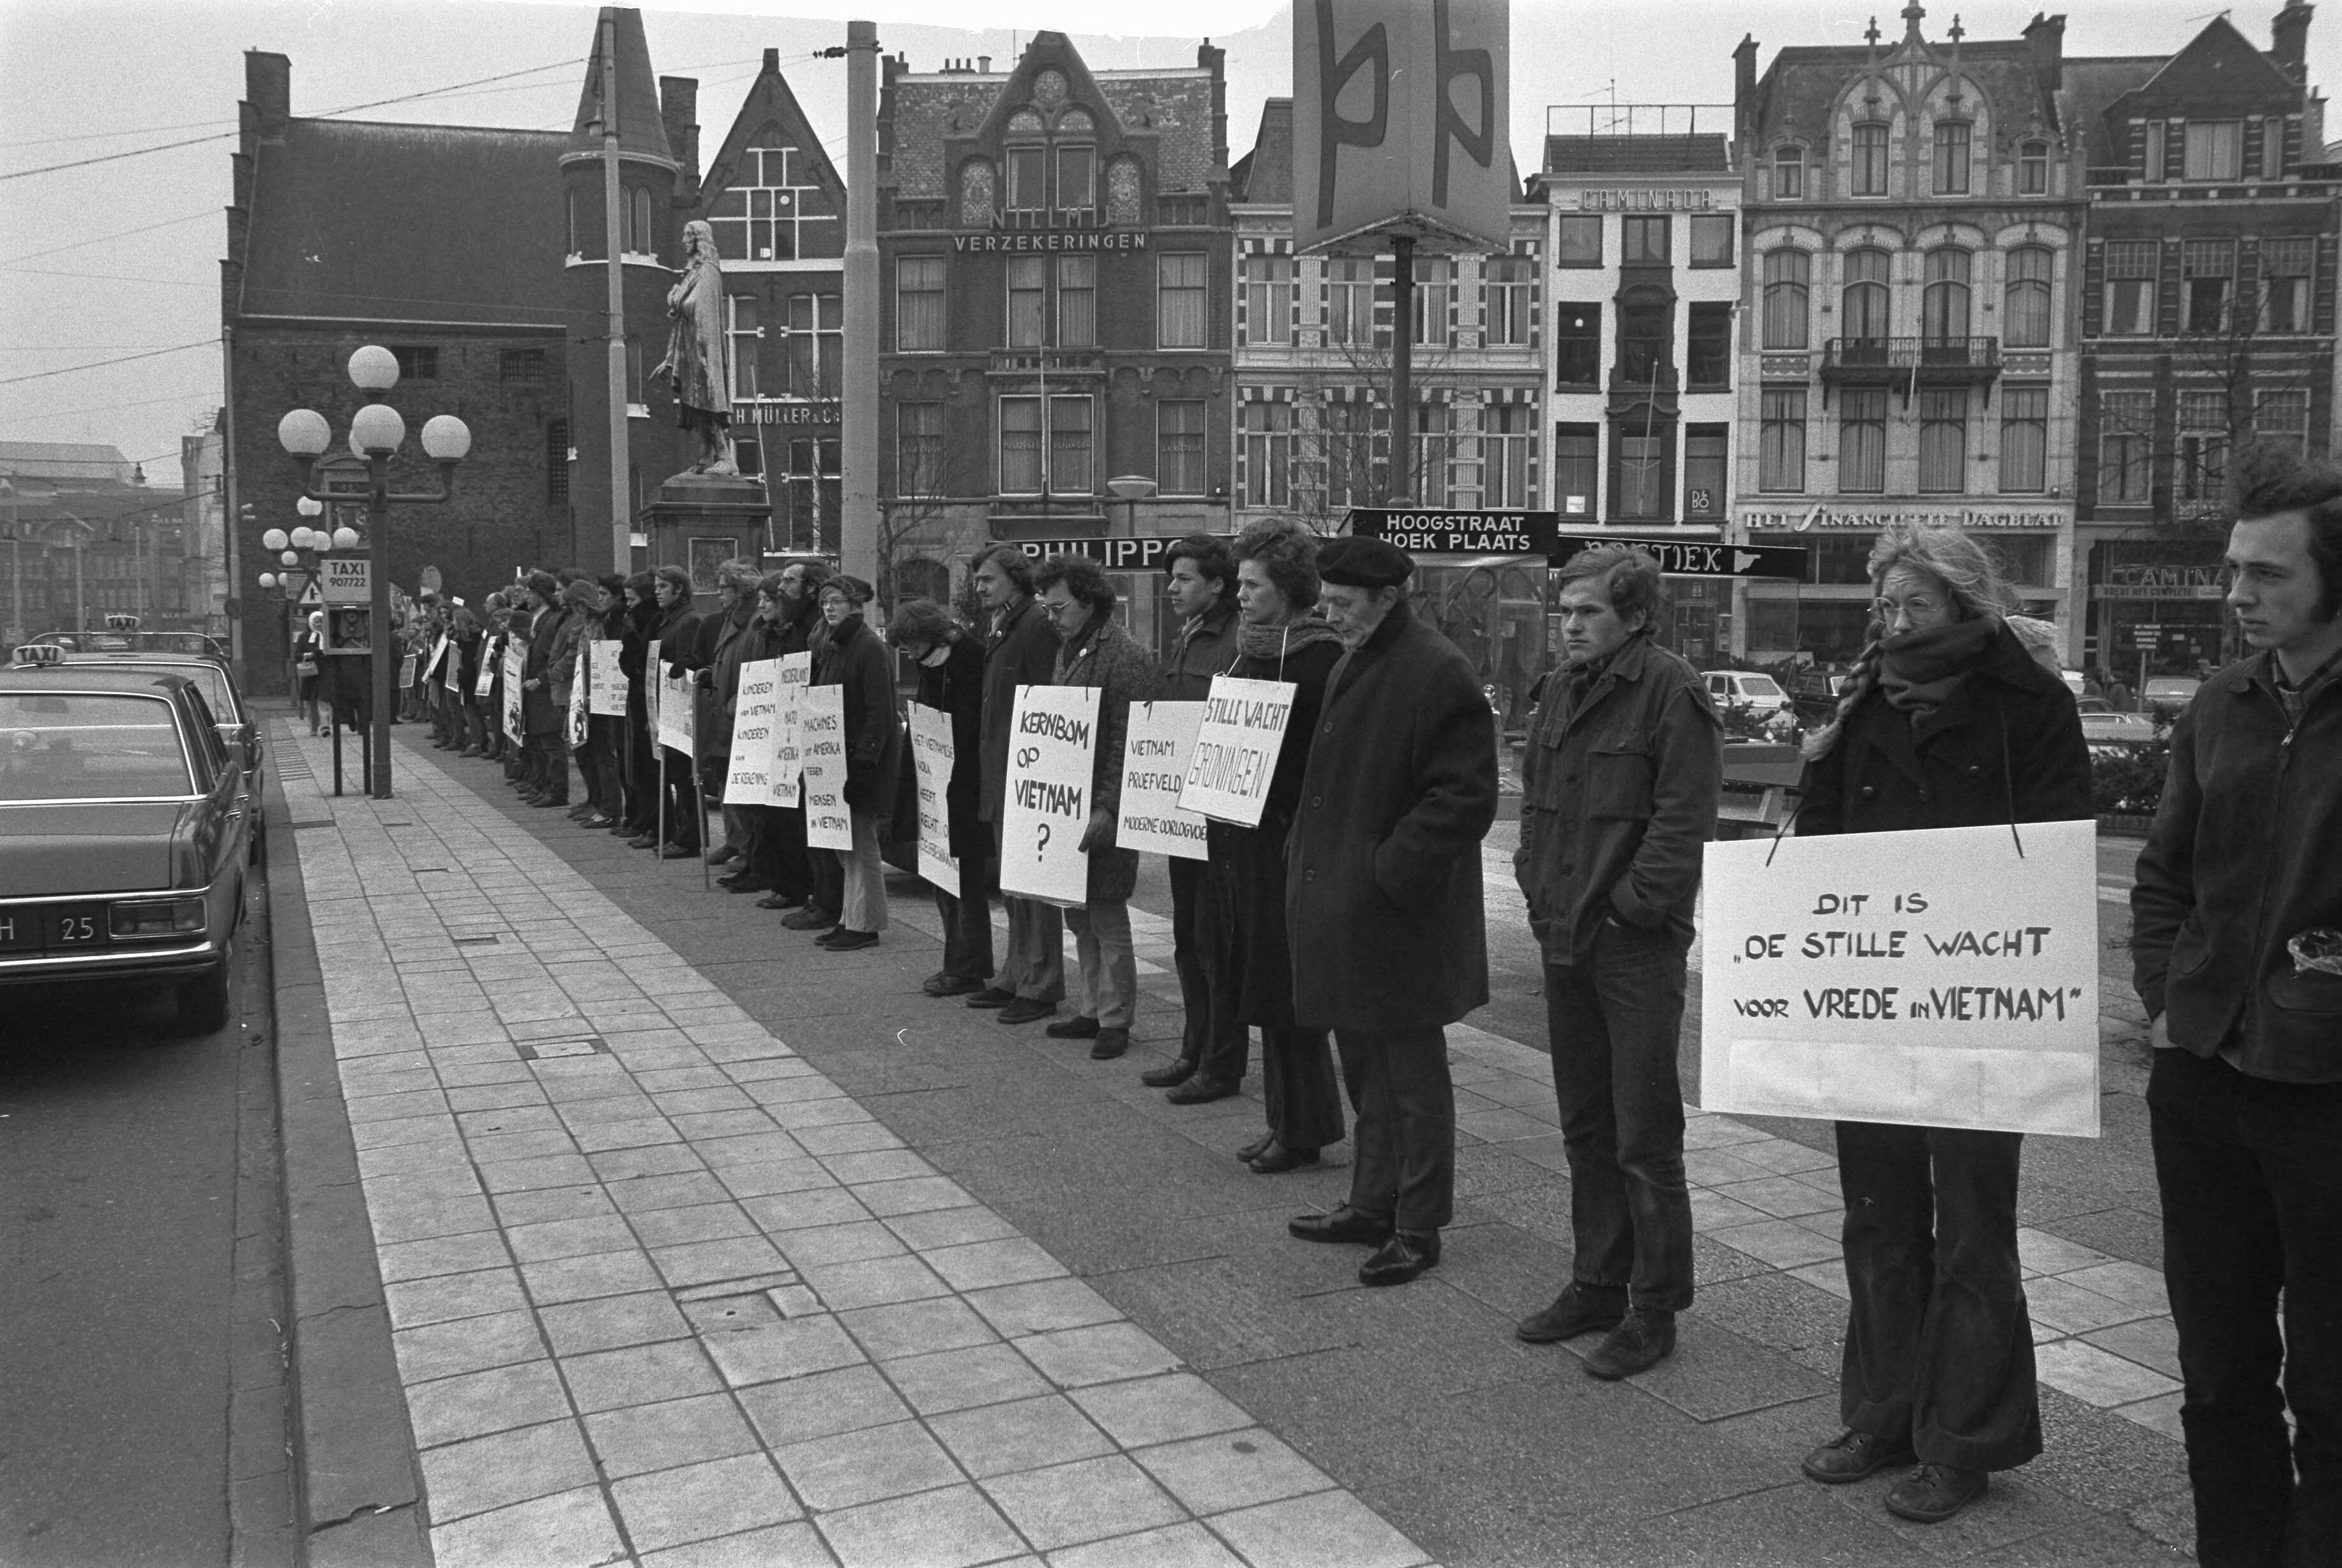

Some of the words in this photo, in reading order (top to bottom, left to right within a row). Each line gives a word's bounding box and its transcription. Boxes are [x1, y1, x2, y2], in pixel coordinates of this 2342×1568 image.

[1584, 189, 1712, 209] CAMINADA
[955, 234, 1145, 251] VERZEKERINGEN
[752, 405, 810, 424] MÜLLER
[1387, 514, 1525, 532] HOOGSTRAAT
[1745, 514, 1787, 527] HET
[1963, 511, 2063, 526] DAGBLAD
[1379, 532, 1437, 549] HOEK
[1449, 533, 1530, 550] PLAATS
[331, 562, 365, 575] TAXI
[329, 577, 366, 587] 907722
[109, 617, 136, 628] TAXI
[17, 647, 58, 662] TAXI
[750, 704, 776, 717] VIETNAM
[1204, 697, 1243, 726] STILLE
[1244, 700, 1289, 732] WACHT
[804, 715, 837, 733] MACHINES
[1020, 711, 1089, 750] KERNBOM
[813, 740, 842, 756] AMERIKA
[1131, 739, 1175, 757] VIETNAM
[1017, 747, 1040, 769] OP
[1188, 743, 1270, 799] GRONINGEN
[1128, 771, 1181, 793] PROEFVELD
[808, 794, 836, 807] MENSEN
[1015, 779, 1082, 820] VIETNAM
[818, 816, 849, 831] VIETNAM
[1124, 816, 1160, 834] MODERNE
[1038, 823, 1050, 863] ?
[1812, 893, 1869, 916] DIT
[1894, 893, 1928, 914] IS
[61, 917, 94, 940] 25
[1802, 930, 1908, 958] STILLE
[1924, 926, 2051, 957] WACHT
[1734, 998, 1789, 1018] VOOR
[1803, 987, 1899, 1020] VREDE
